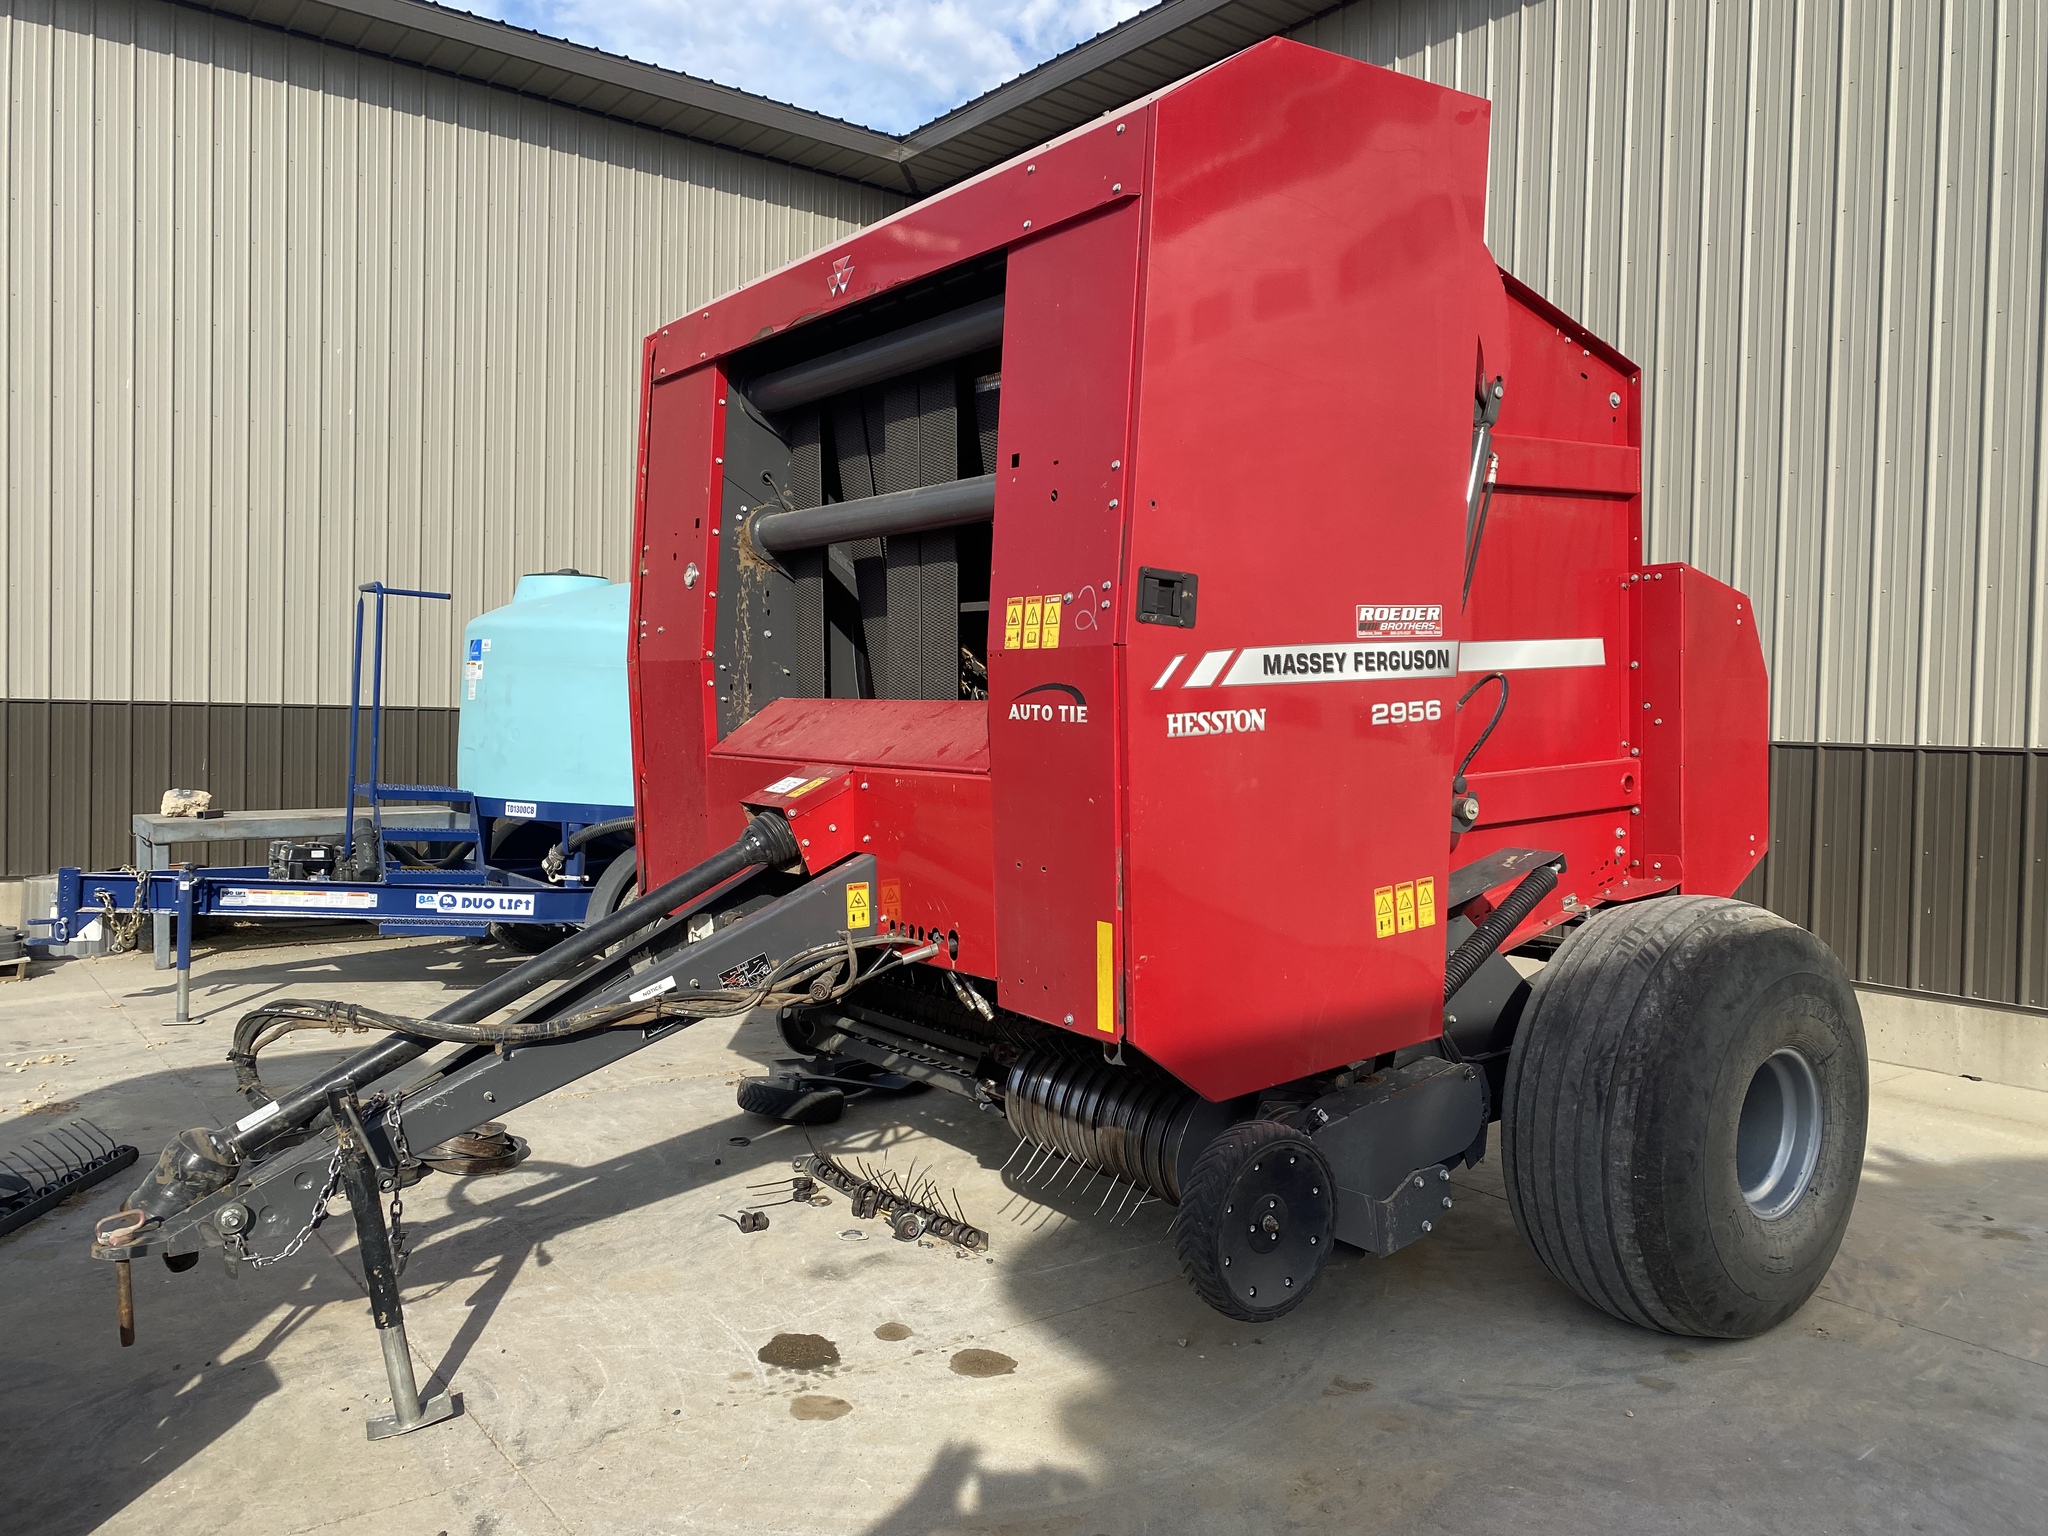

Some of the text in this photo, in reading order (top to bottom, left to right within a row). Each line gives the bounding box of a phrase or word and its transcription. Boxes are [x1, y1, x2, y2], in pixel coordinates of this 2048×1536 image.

[1074, 585, 1098, 631] 2
[1359, 607, 1440, 621] ROEDER
[1380, 622, 1436, 631] BROTHERS
[1263, 649, 1450, 676] MASSEY FERGUSON
[1008, 703, 1088, 723] AUTO TIE
[1166, 708, 1266, 738] HESSTON
[1371, 700, 1442, 726] 2956
[461, 897, 495, 909] DUO
[642, 984, 664, 997] NOTICE
